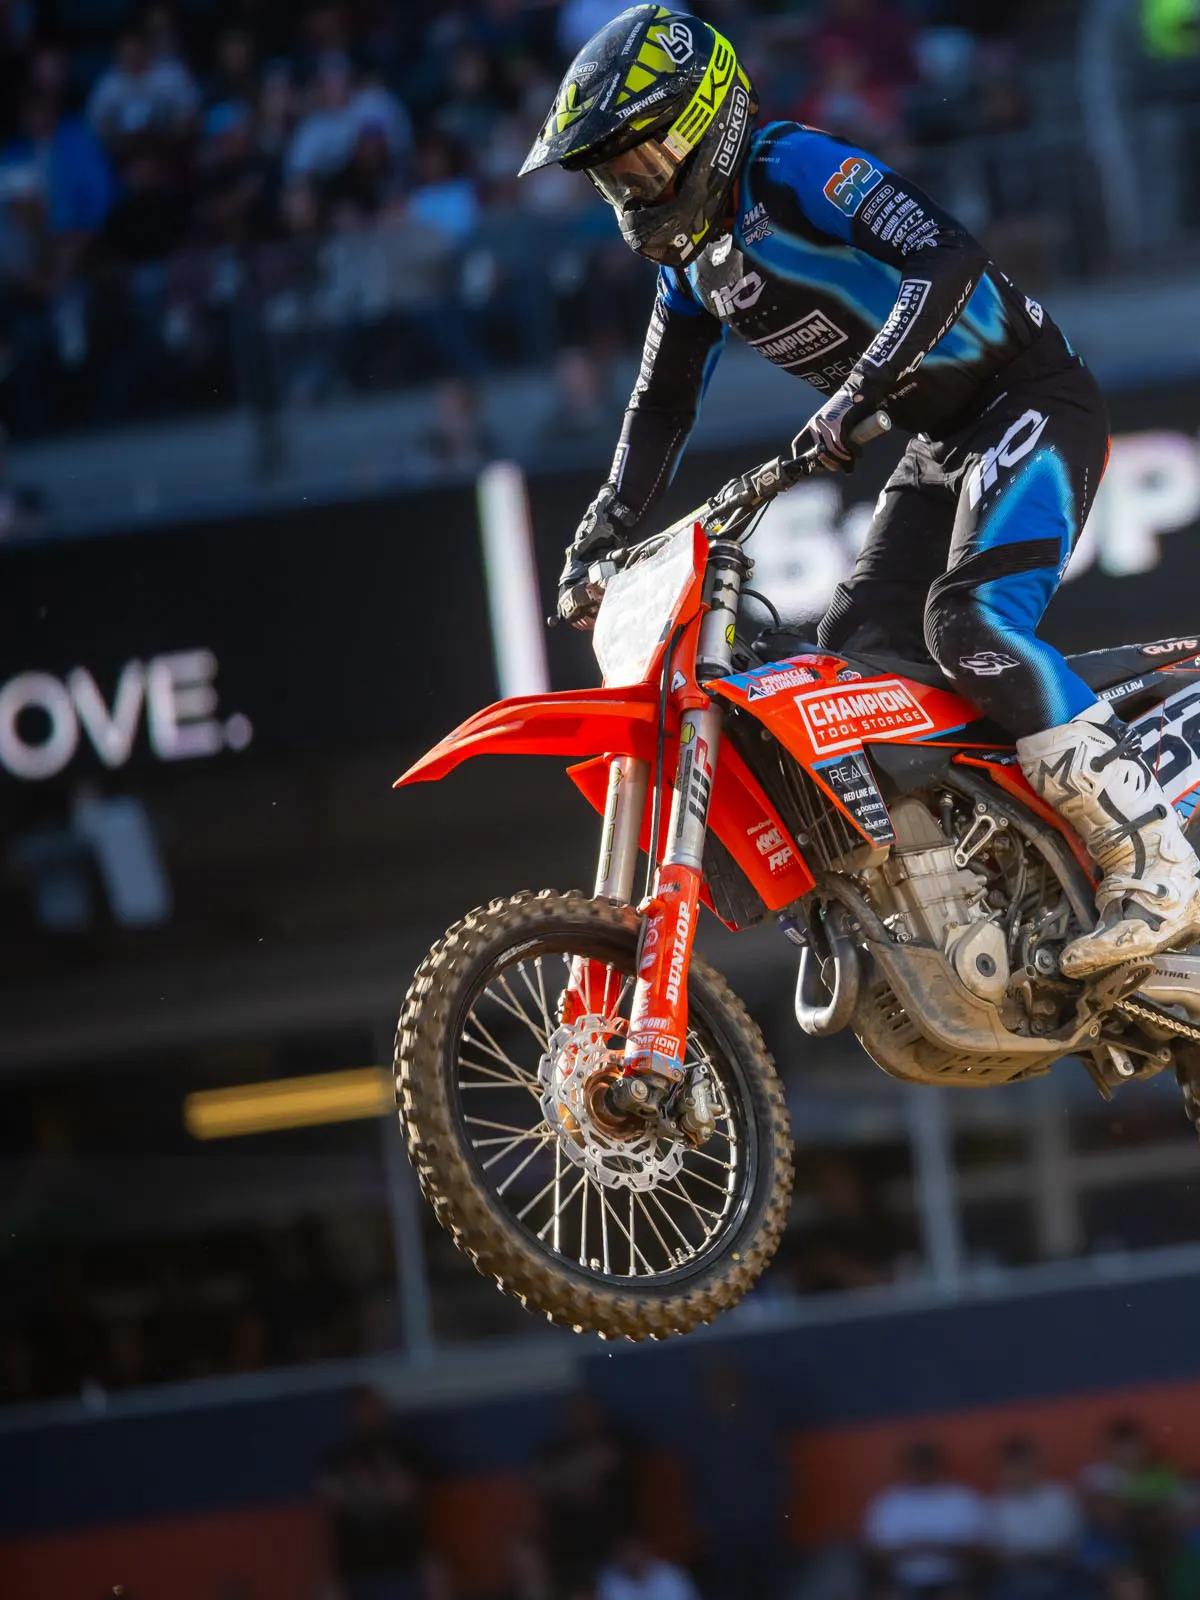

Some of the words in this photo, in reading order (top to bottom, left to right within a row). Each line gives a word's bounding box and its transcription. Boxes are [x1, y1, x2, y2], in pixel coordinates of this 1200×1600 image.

[717, 91, 748, 168] DECKED
[822, 157, 884, 217] 62
[863, 187, 892, 220] DECKED
[1142, 638, 1199, 655] GUTS
[760, 666, 809, 686] PINNACLE
[806, 685, 914, 728] CHAMPION
[817, 724, 859, 741] TOOL
[860, 709, 922, 731] STORAGE
[666, 900, 692, 1006] DUNLOP
[1153, 967, 1191, 980] NTHAL
